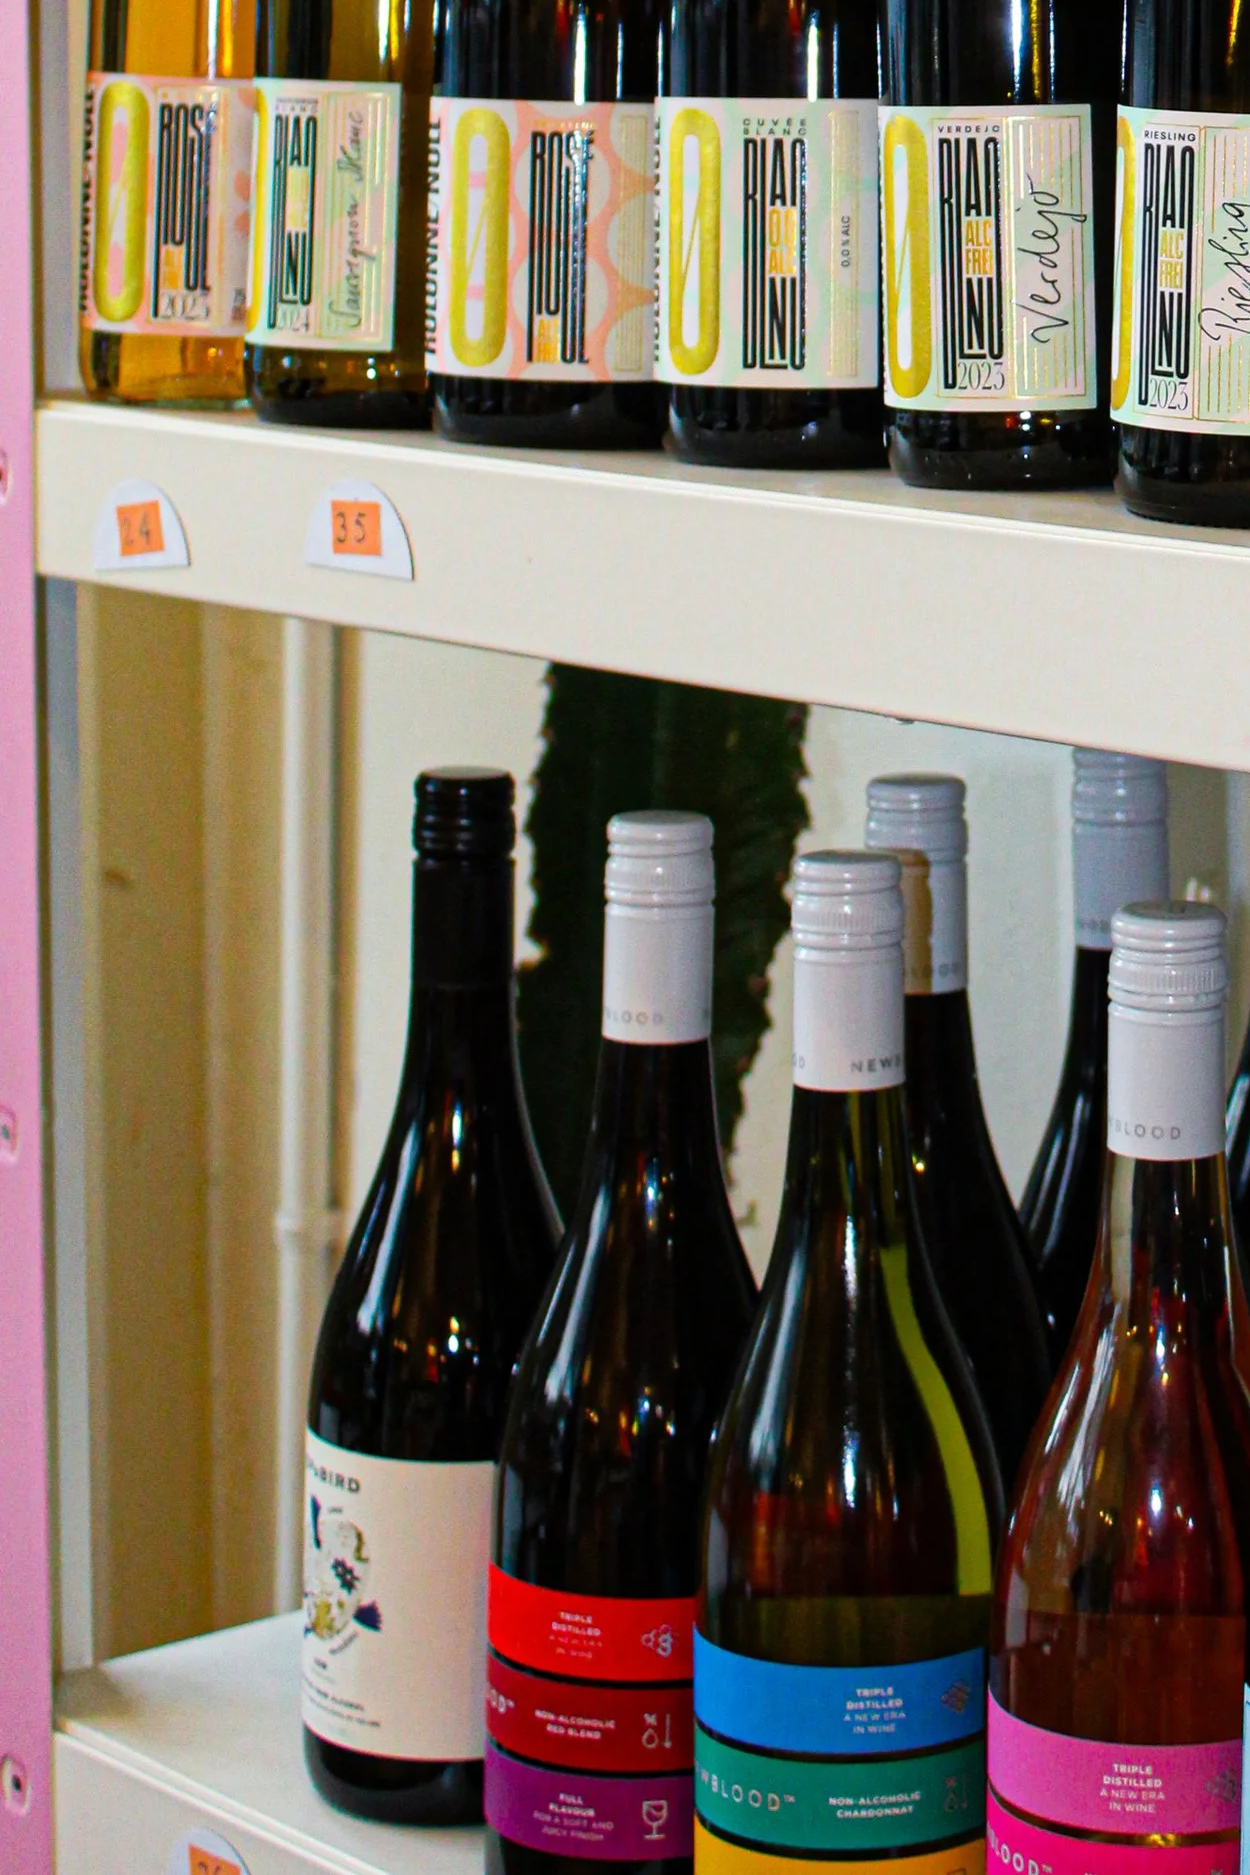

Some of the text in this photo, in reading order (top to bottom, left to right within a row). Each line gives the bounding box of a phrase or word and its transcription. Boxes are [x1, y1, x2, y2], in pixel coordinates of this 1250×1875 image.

[743, 117, 807, 127] CUVÉE
[1144, 130, 1196, 142] RIESLING
[965, 220, 992, 247] ALC
[1160, 231, 1184, 260] ALC
[965, 248, 992, 276] FREI
[1013, 172, 1088, 344] Verdejo
[1159, 260, 1183, 289] FREI
[1149, 378, 1189, 411] 2023
[335, 510, 367, 545] 35
[560, 1611, 593, 1624] TRIPLE
[551, 1621, 601, 1637] DISTILLED
[855, 1686, 893, 1698] TRIPLE
[846, 1698, 904, 1711] DISTILLED
[535, 1709, 616, 1730] NON-ALCOHOLIC
[843, 1710, 906, 1722] A NEW ERA
[546, 1723, 602, 1740] RED BLEND
[853, 1724, 896, 1734] IN WINE
[1113, 1763, 1153, 1775] TRIPLE
[1103, 1775, 1162, 1788] DISTILLED
[559, 1792, 584, 1805] FULL
[828, 1791, 921, 1807] NON-ALCOHOLIC
[1100, 1788, 1166, 1801] A NEW ERA
[549, 1802, 596, 1817] FLAVOUR
[836, 1804, 914, 1819] CHARDONNAY
[1109, 1801, 1156, 1813] IN WINE
